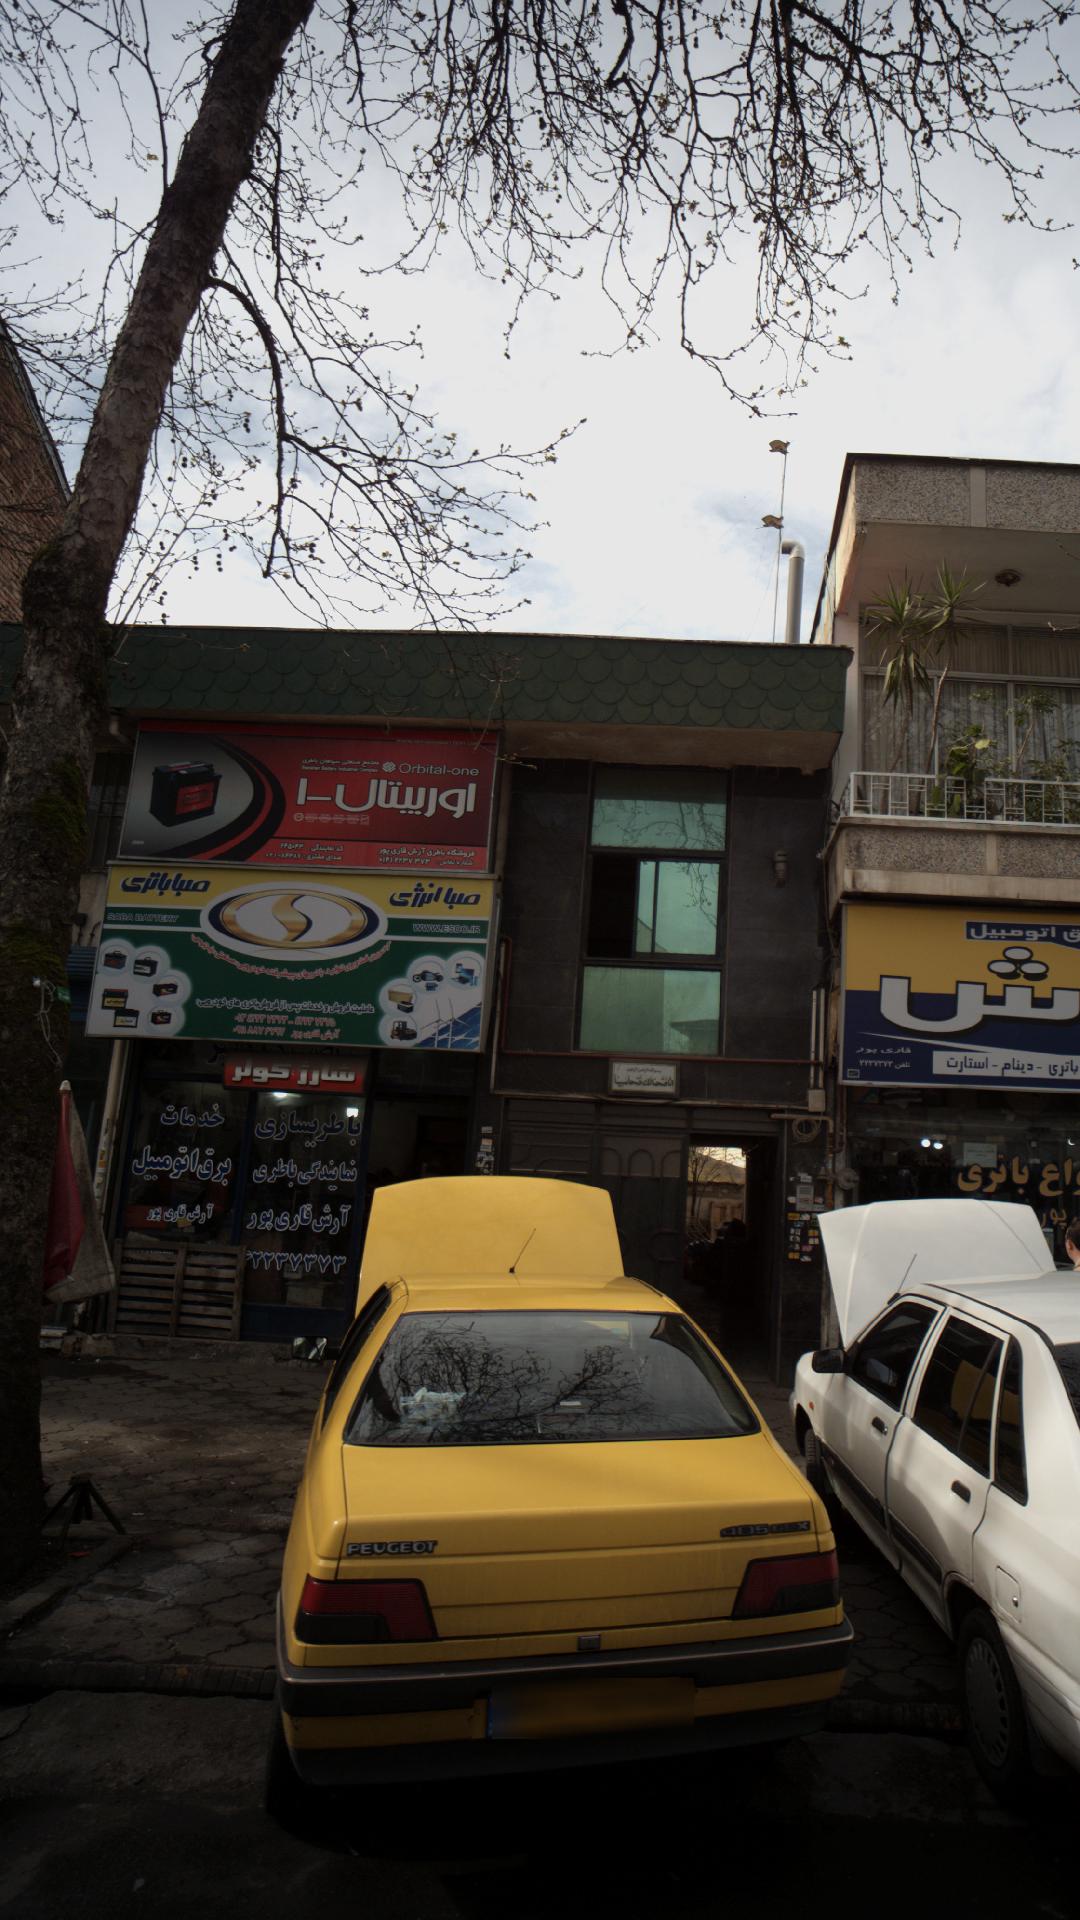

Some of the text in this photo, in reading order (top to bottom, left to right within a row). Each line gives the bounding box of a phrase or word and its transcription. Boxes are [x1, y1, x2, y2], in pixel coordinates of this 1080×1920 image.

[399, 763, 480, 776] Orbital-one
[408, 847, 426, 856] آرش
[389, 882, 481, 910] صبا انرژی
[970, 923, 1056, 942] اتومبیل
[232, 1060, 291, 1083] کولر
[946, 1057, 1080, 1078] باتری دینام استارت
[160, 1103, 225, 1127] خدمات
[131, 1145, 232, 1186] برق اتومبیل
[252, 1158, 358, 1191] نمایندگی باطری
[957, 1153, 1030, 1195] باتری
[163, 1203, 187, 1222] قاری
[186, 1203, 215, 1224] آرش
[246, 1203, 352, 1235] آرش قاری پور
[347, 1541, 437, 1556] PEUGEOT
